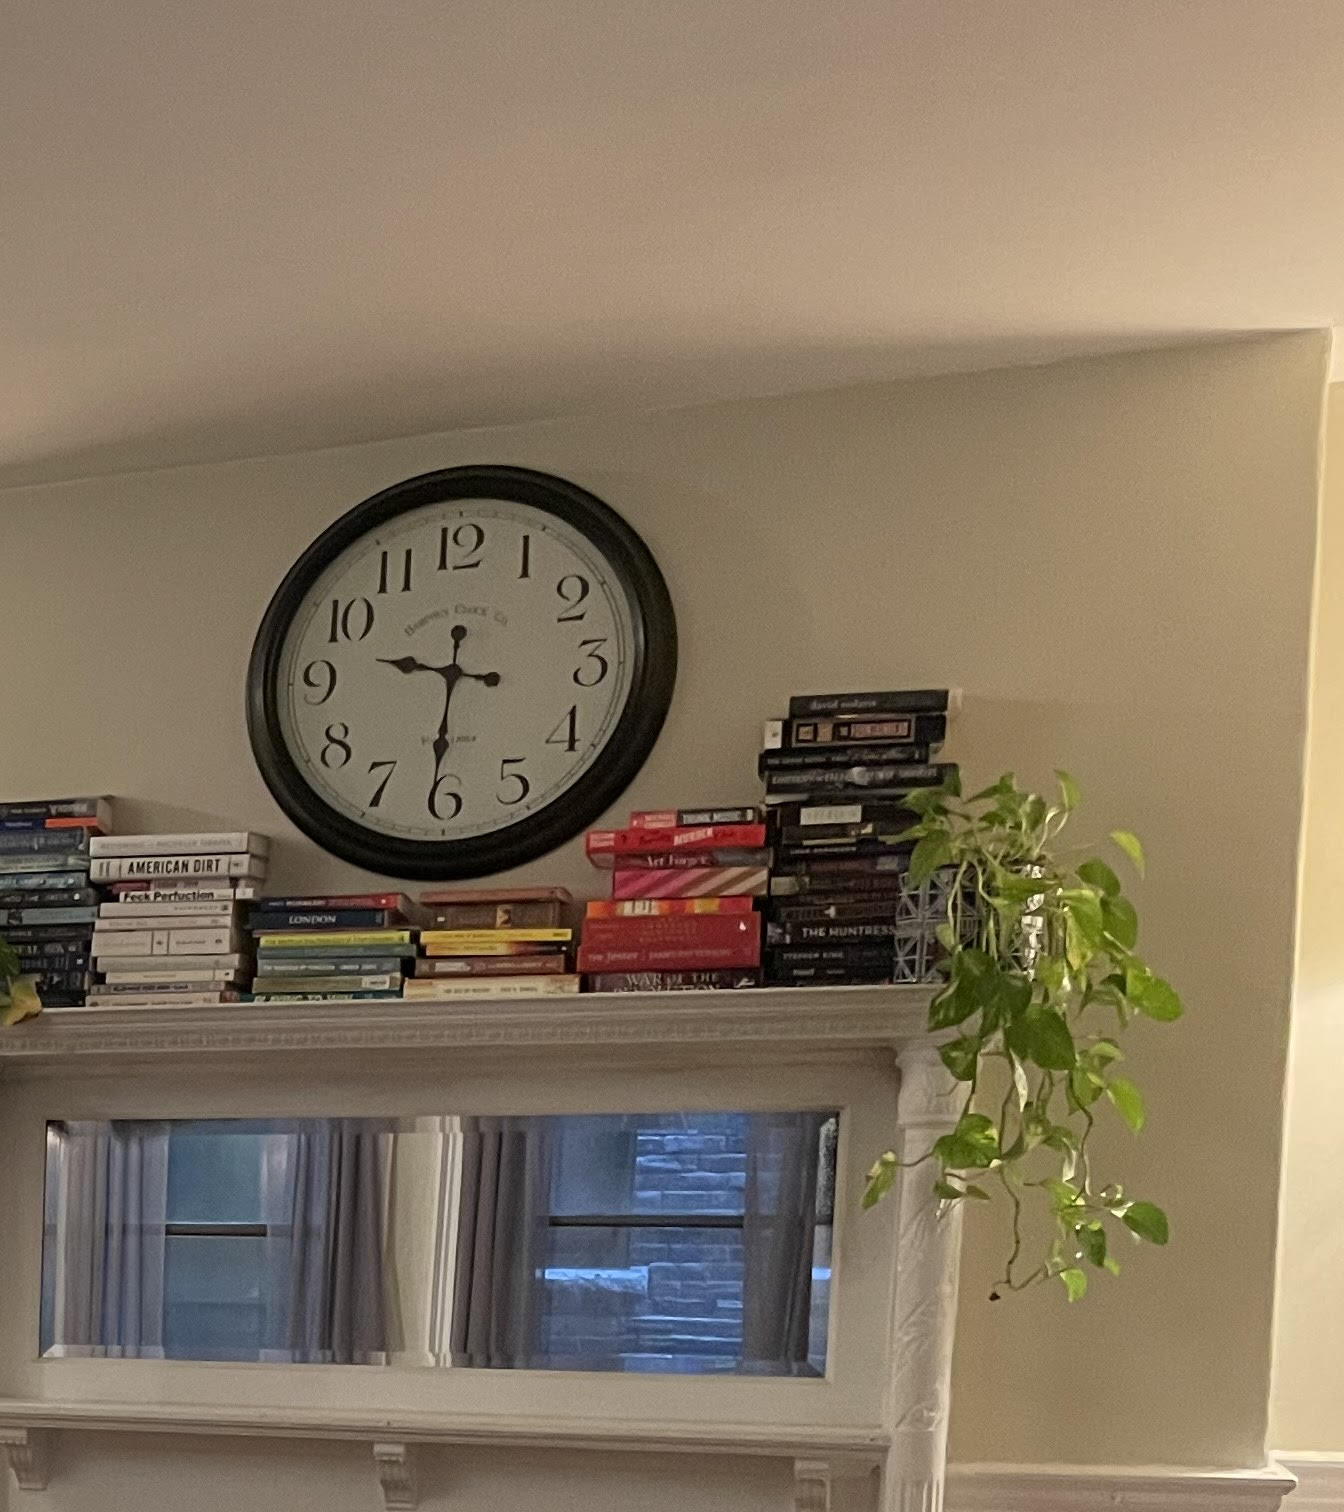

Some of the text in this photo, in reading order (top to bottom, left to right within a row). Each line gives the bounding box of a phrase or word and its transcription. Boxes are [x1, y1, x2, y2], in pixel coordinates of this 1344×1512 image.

[437, 523, 485, 571] 12
[518, 534, 530, 580] 1
[377, 548, 412, 594] 11
[328, 597, 375, 643] 10
[556, 574, 590, 623] 2
[303, 659, 337, 706] 9
[572, 638, 608, 687] 3
[320, 722, 352, 769] 8
[544, 704, 582, 753] 4
[367, 760, 398, 808] 7
[427, 773, 463, 821] 6
[495, 757, 530, 806] 5
[127, 858, 221, 875] AMERICAN DIRT
[288, 914, 337, 925] LONDON
[801, 926, 826, 938] THE
[625, 972, 662, 986] WAR
[691, 972, 719, 983] THE
